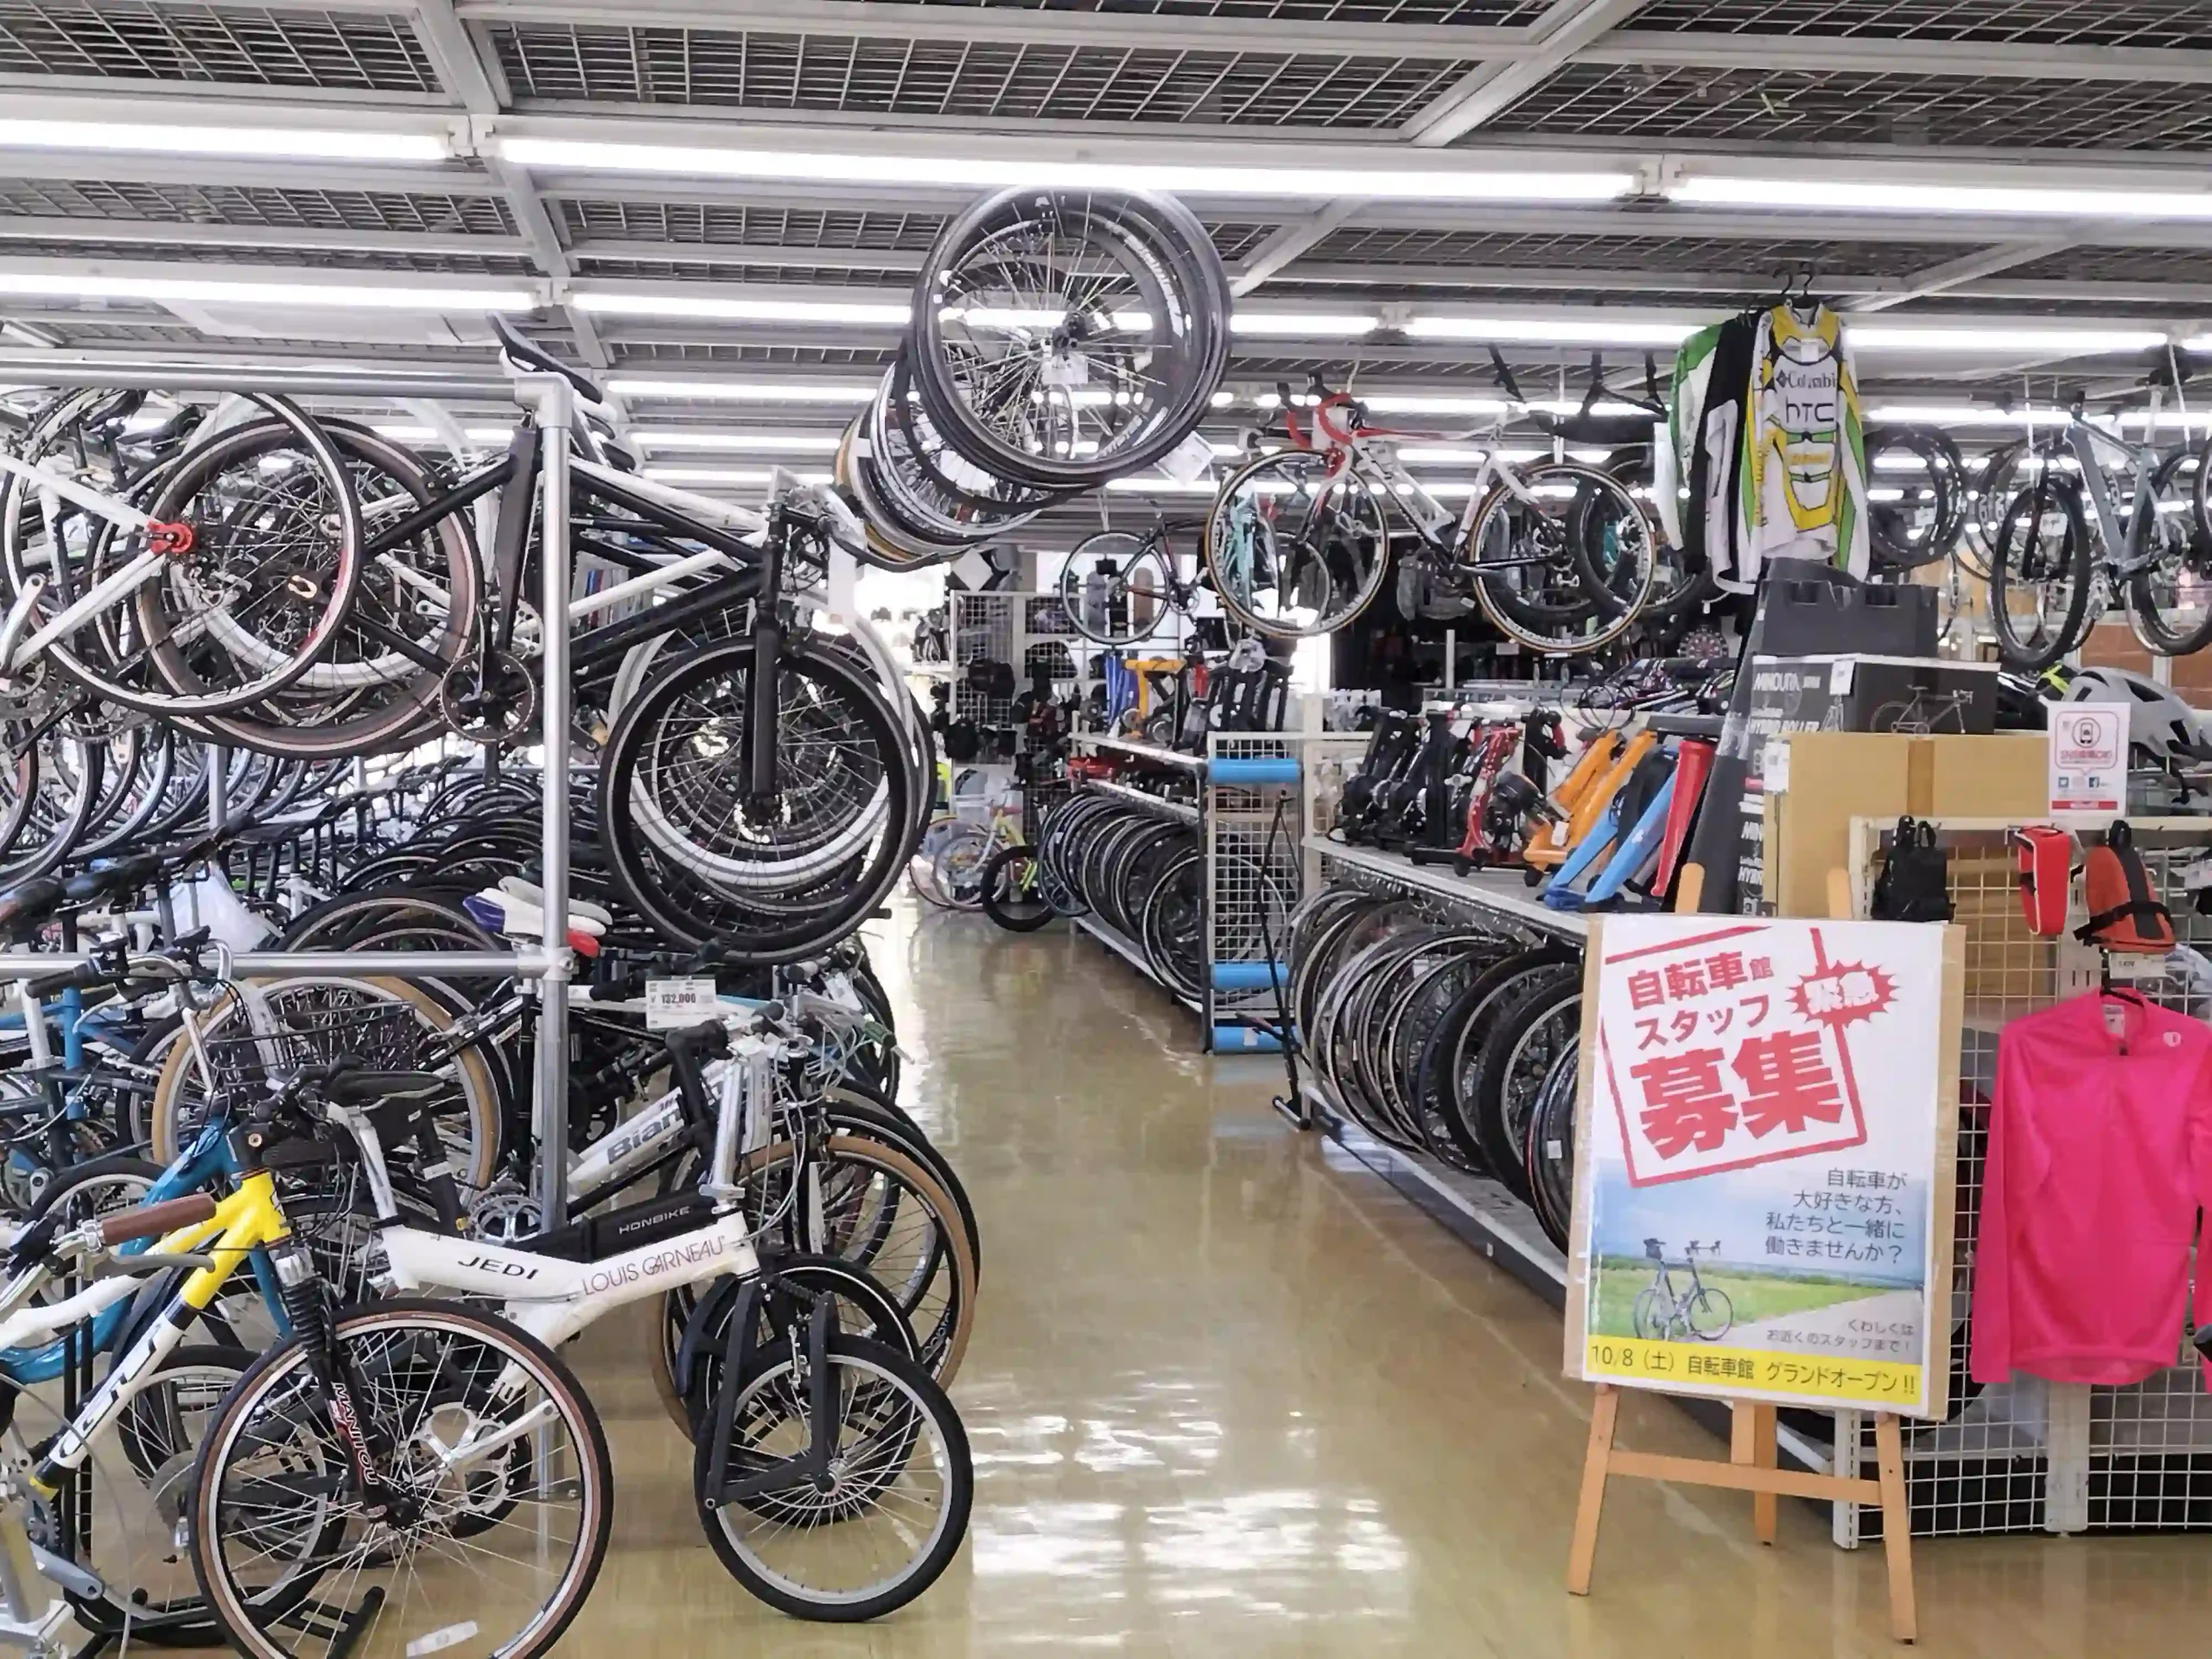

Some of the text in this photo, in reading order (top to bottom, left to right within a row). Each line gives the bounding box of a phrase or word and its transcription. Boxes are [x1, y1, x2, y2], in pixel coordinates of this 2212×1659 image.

[1635, 995, 1770, 1050] スタッフ
[1630, 1031, 1844, 1160] 募集
[1827, 1167, 1908, 1190] 自転車が
[1793, 1190, 1902, 1215] 大好きな方、
[619, 1206, 690, 1235] HONBIKE
[1766, 1211, 1904, 1239] 私たちと一緒に
[457, 1256, 538, 1280] JEDI
[582, 1236, 724, 1296] LOUIS GARNEAU
[1848, 1319, 1914, 1335] くわしくは
[1688, 1356, 1755, 1380] 自転車館
[331, 1382, 379, 1485] MANITOU
